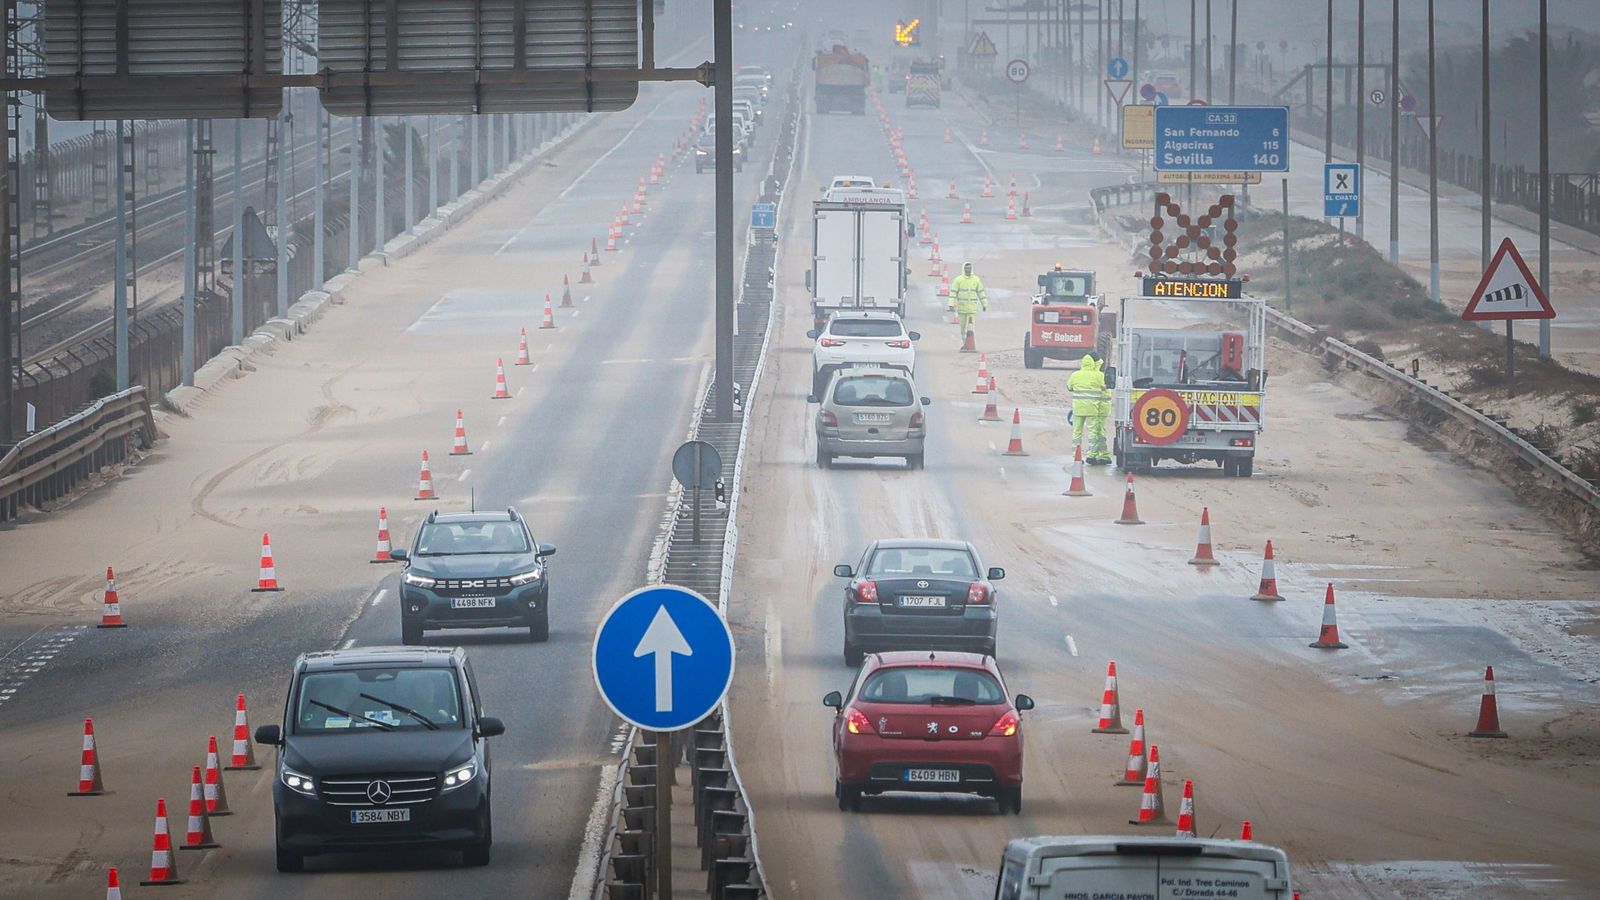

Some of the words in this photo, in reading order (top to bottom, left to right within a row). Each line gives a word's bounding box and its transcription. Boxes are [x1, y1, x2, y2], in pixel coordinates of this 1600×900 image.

[1011, 67, 1025, 76] 80
[1164, 128, 1185, 137] San
[1190, 128, 1240, 137] Fernando
[1272, 128, 1280, 137] 6
[1164, 141, 1214, 151] Algeciras
[1263, 141, 1280, 150] 115
[1164, 153, 1213, 165] Sevilla
[1252, 154, 1280, 166] 140
[843, 196, 892, 204] AMBULANCIA
[1155, 281, 1229, 298] ATENCION
[1054, 333, 1082, 343] Bobcat
[1145, 407, 1177, 427] 80
[478, 598, 493, 606] NFK
[905, 597, 924, 606] 1707
[928, 597, 943, 606] FJL
[911, 770, 936, 780] 6409
[938, 770, 958, 781] HBN
[358, 811, 383, 821] 3584
[387, 810, 406, 821] NBY
[1161, 878, 1177, 886] Pol.
[1196, 879, 1213, 887] Tres
[1214, 880, 1250, 888] Caminos
